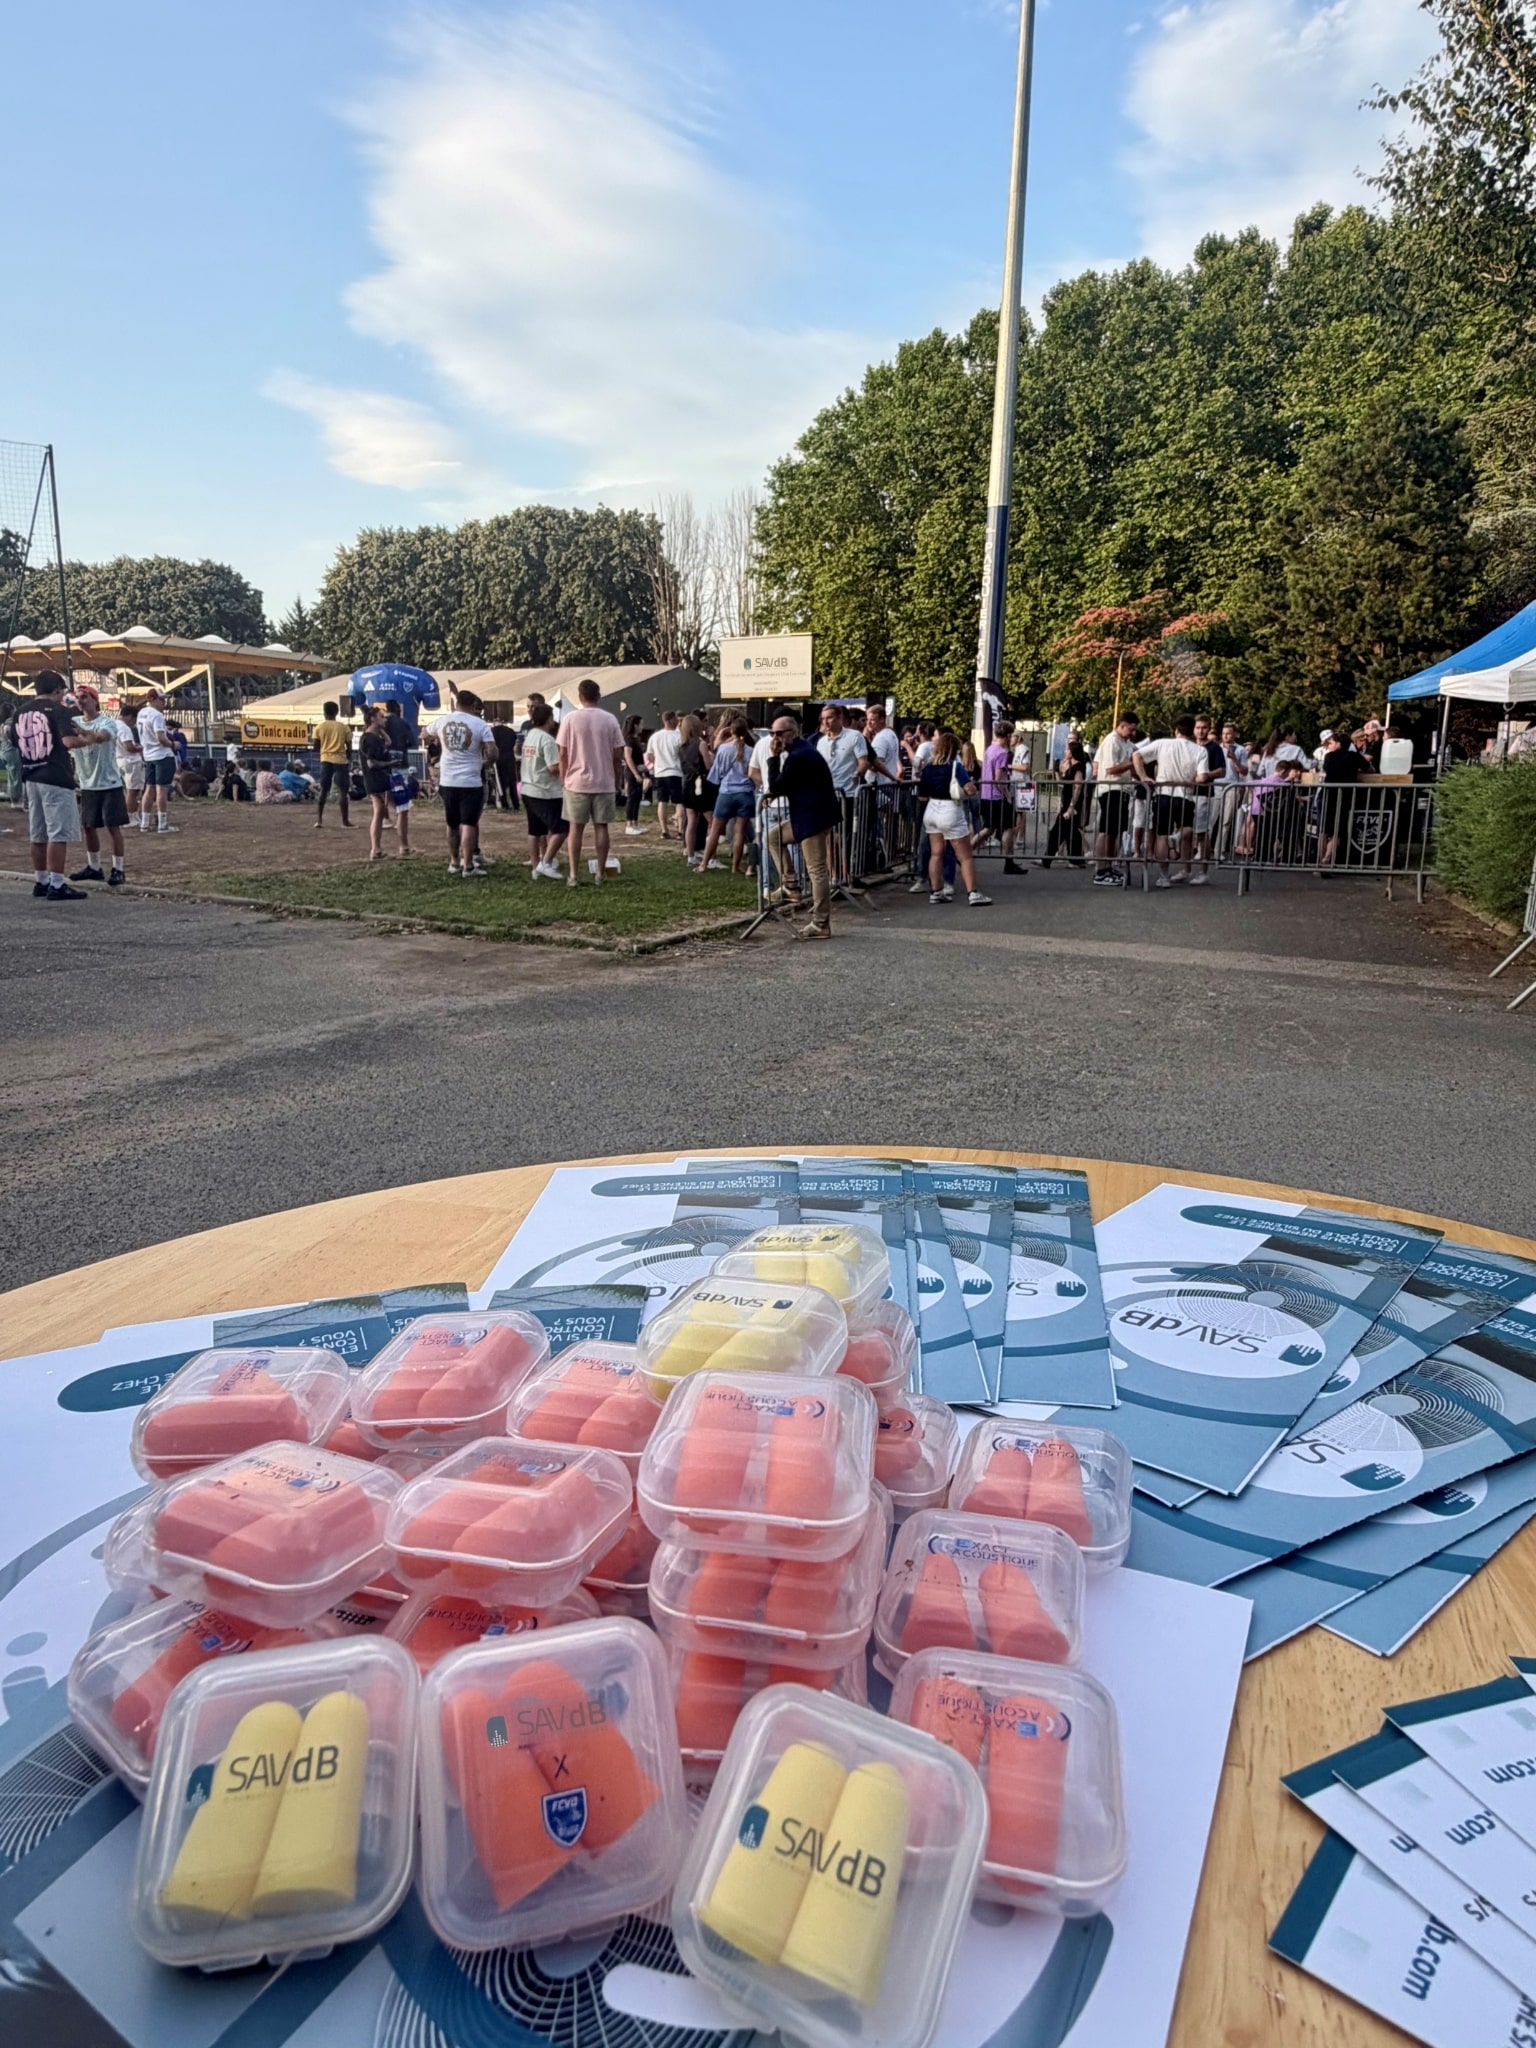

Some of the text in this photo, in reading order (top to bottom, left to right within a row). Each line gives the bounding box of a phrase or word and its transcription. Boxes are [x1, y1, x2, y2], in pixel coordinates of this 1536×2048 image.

[755, 657, 788, 668] SAVdB
[260, 724, 281, 737] Tonic
[283, 725, 306, 738] radio
[693, 1292, 767, 1308] SAVdB
[565, 1316, 606, 1325] VOUS
[311, 1330, 355, 1345] VOUS
[566, 1333, 580, 1341] SI
[1119, 1310, 1268, 1354] SAVdB
[111, 1375, 160, 1391] CHEZ
[1015, 1438, 1065, 1450] EXACT
[956, 1538, 1010, 1553] EXACT
[951, 1549, 1039, 1567] ACOUSTIQUE
[517, 1700, 606, 1737] SAVdB
[226, 1745, 339, 1793] SAVdB
[553, 1754, 569, 1779] X
[1482, 1757, 1536, 1785] .com
[774, 1817, 887, 1898] SAVdB
